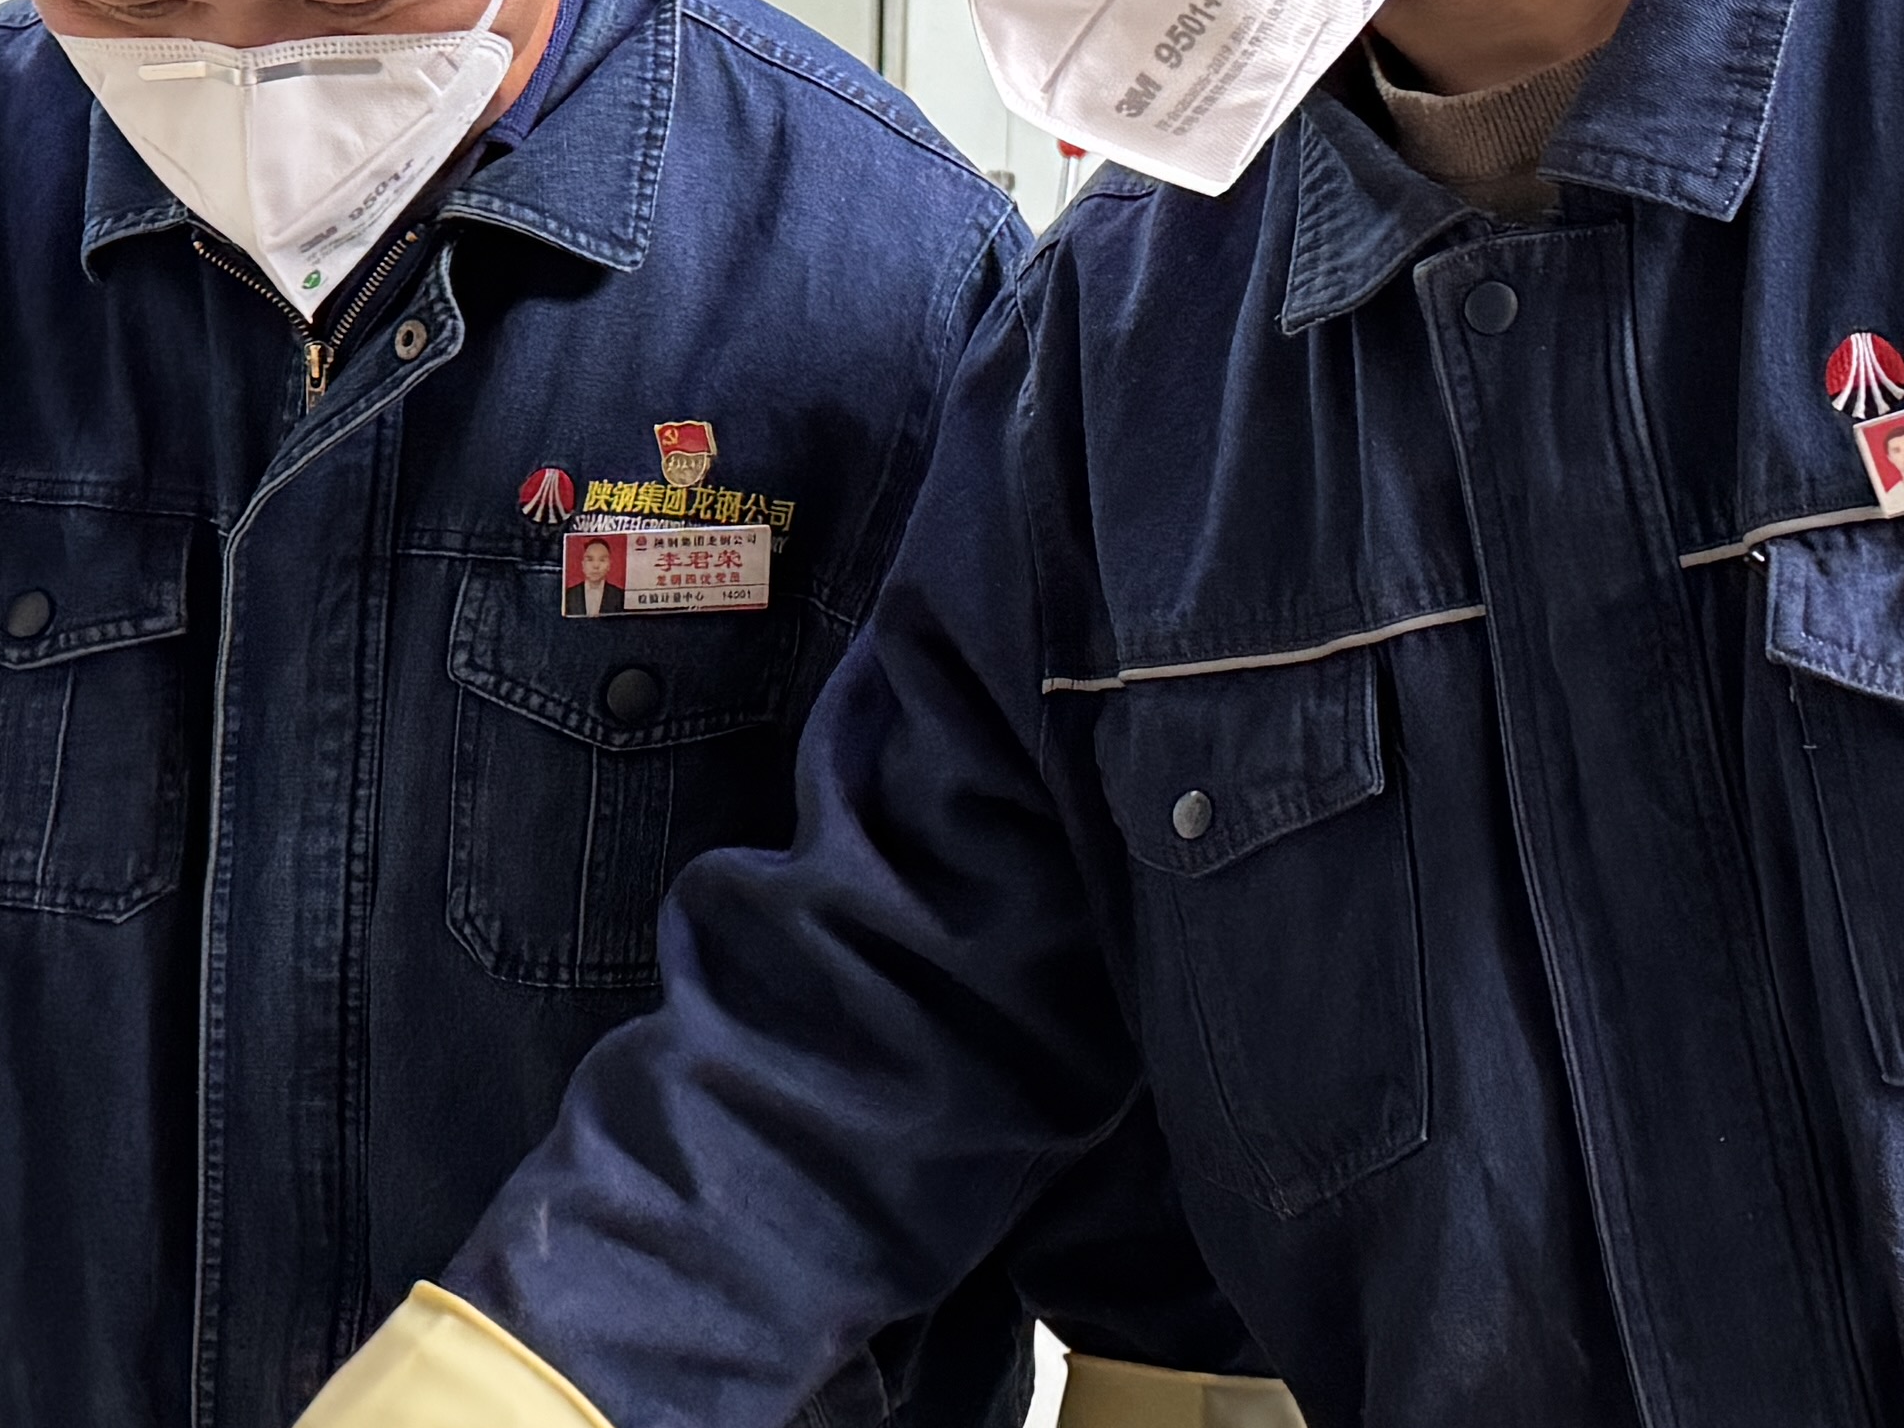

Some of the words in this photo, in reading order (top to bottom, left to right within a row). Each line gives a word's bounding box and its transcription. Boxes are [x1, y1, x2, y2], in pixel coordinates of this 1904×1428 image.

[1115, 72, 1163, 119] 3M
[582, 479, 796, 532] 陕钢集团龙钢公司
[654, 549, 744, 572] 李君荣
